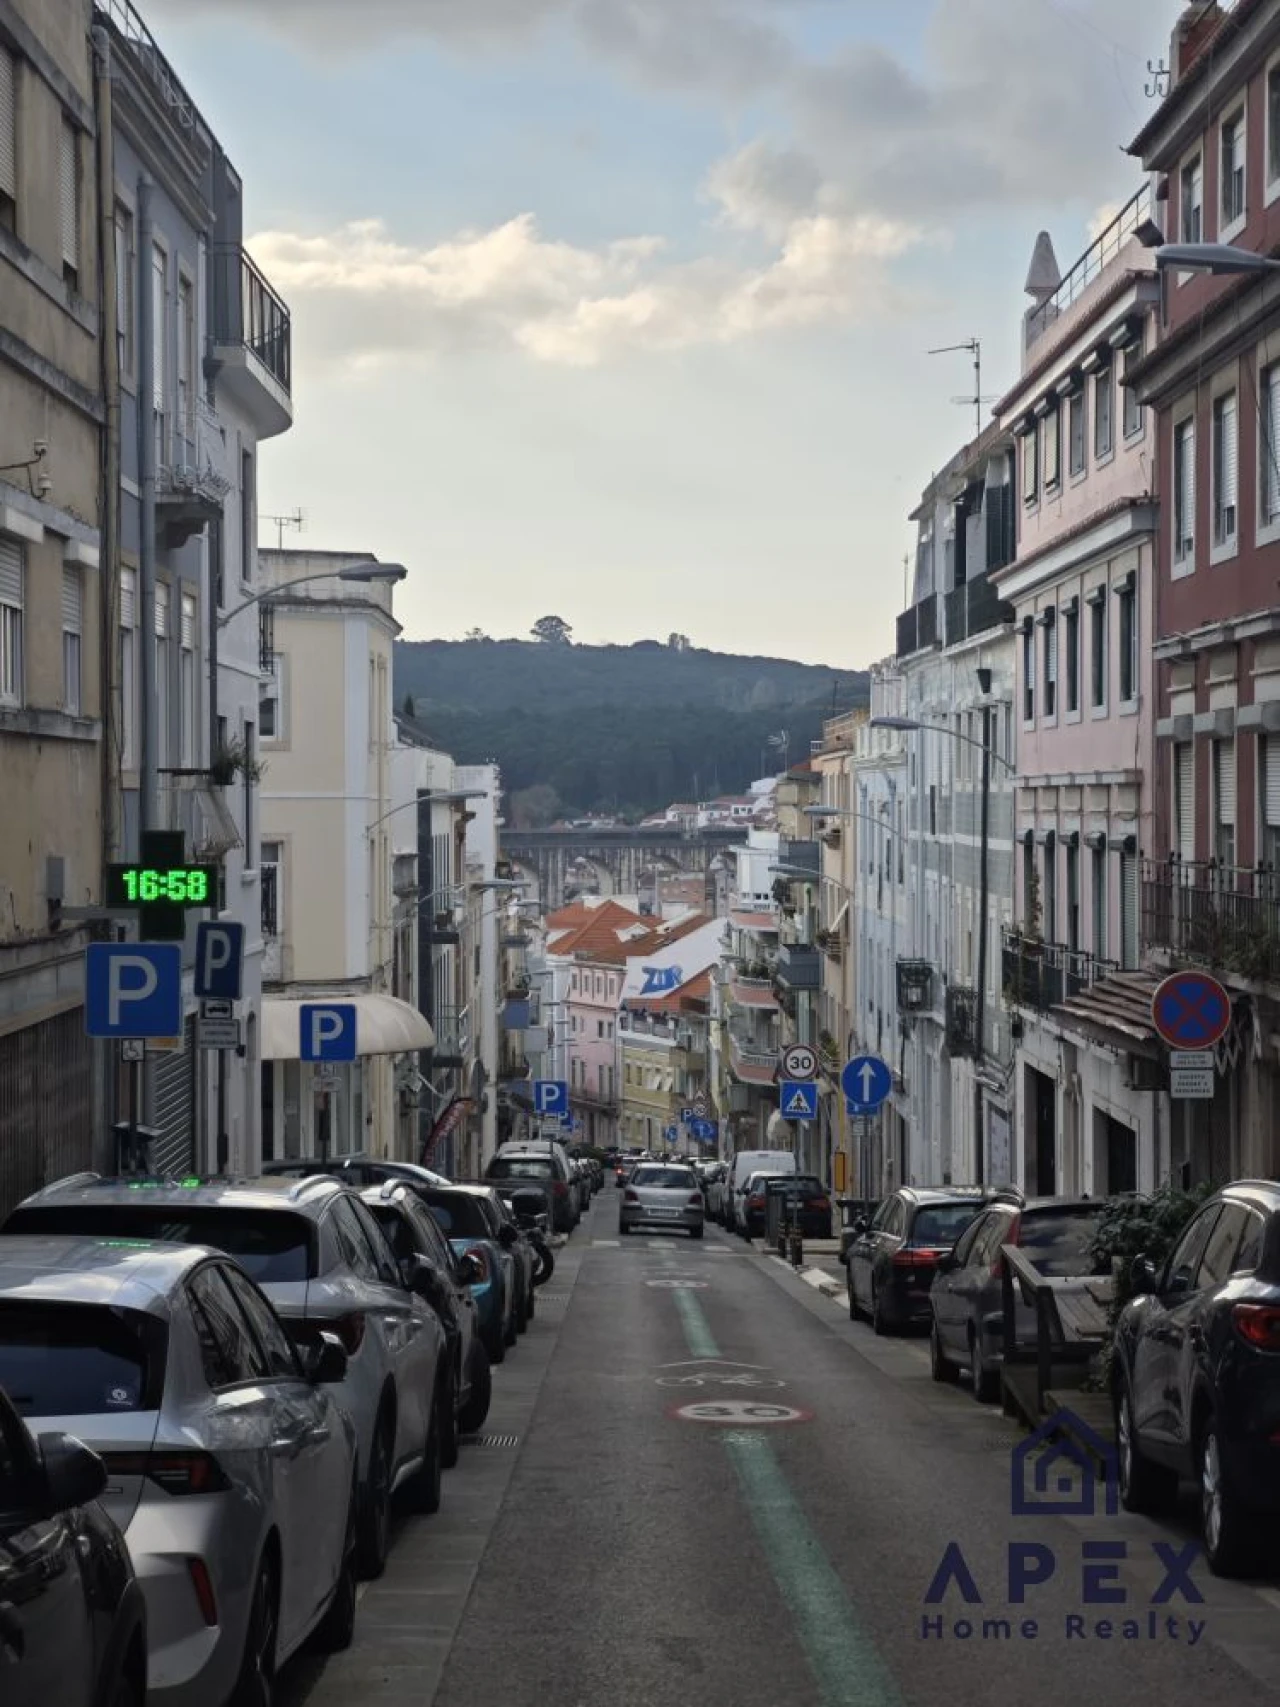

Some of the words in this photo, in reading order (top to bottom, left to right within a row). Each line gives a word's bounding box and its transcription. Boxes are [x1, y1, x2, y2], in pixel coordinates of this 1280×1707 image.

[122, 869, 207, 901] 16:58
[204, 929, 231, 991] P
[108, 955, 158, 1026] P
[311, 1009, 344, 1057] P
[790, 1056, 812, 1070] 30
[540, 1083, 560, 1110] P
